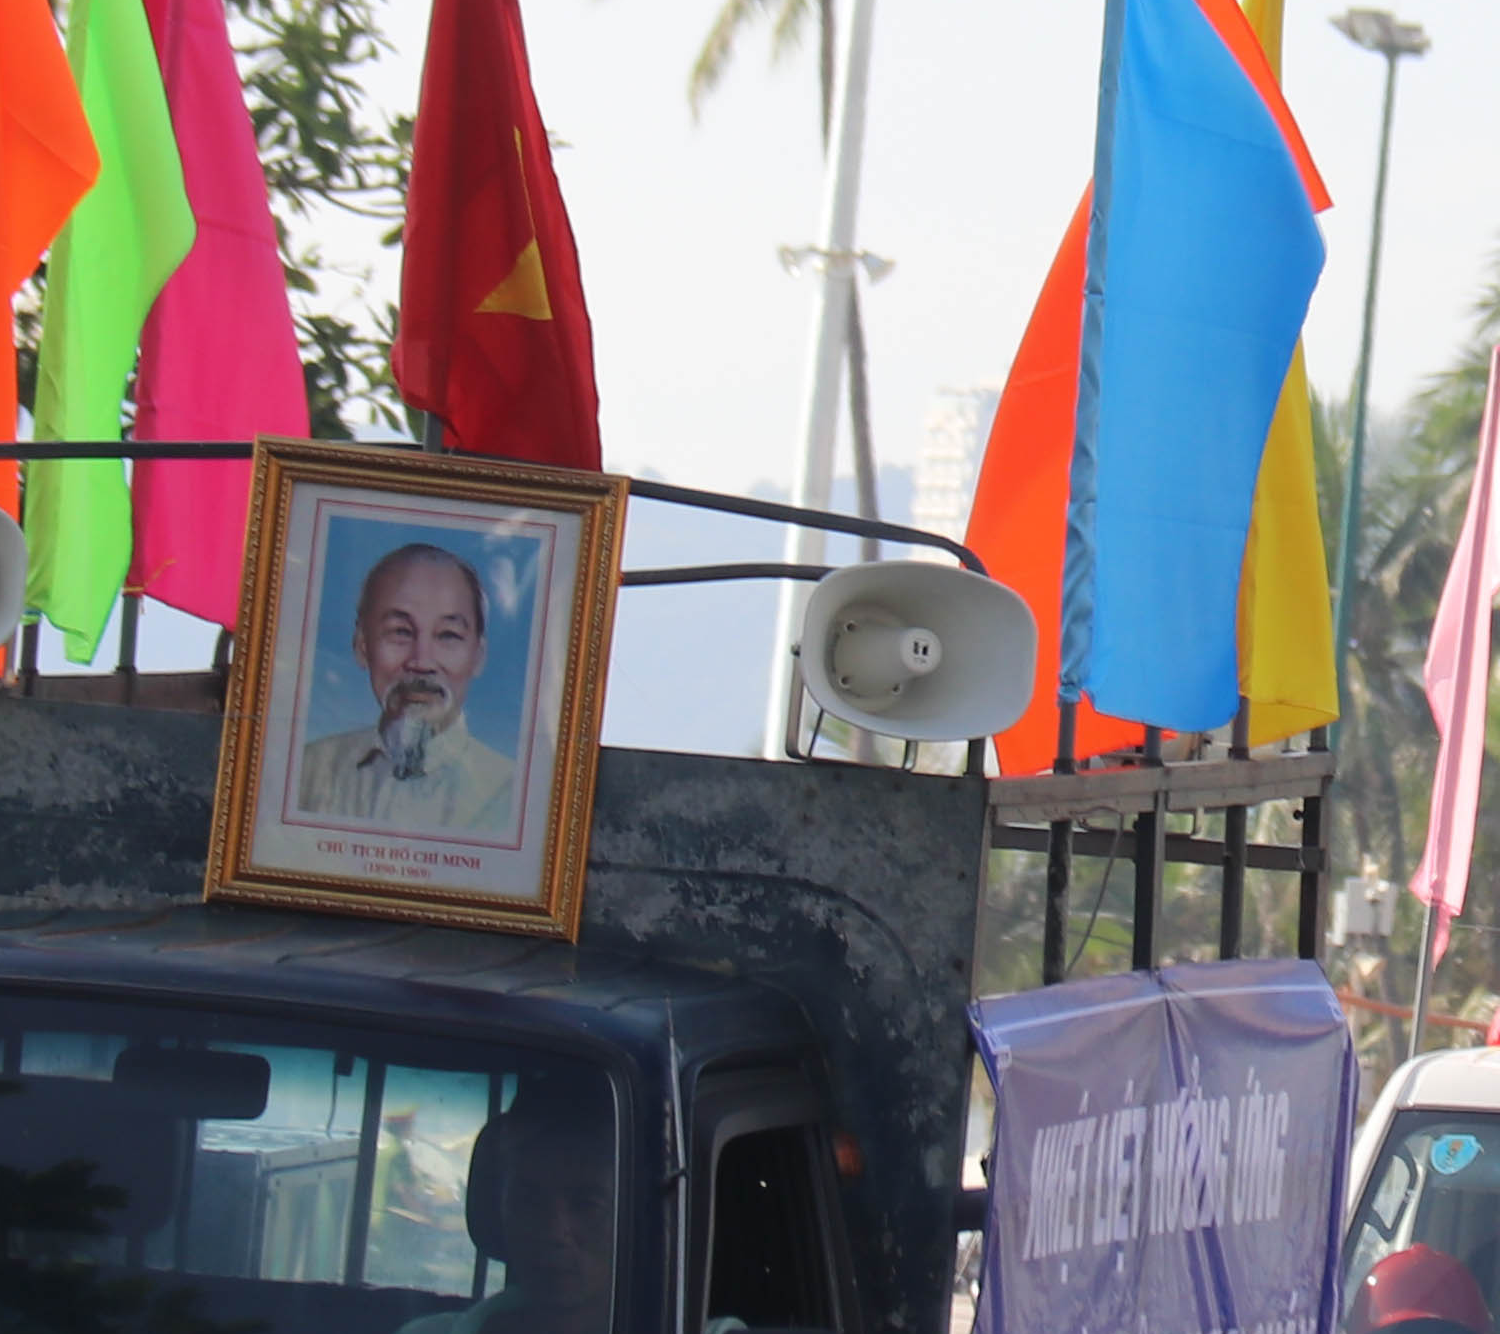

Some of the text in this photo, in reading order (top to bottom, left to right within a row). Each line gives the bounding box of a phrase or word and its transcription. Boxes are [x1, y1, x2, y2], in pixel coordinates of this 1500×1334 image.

[351, 843, 386, 860] TỊCH
[442, 854, 482, 870] MINH
[1092, 1078, 1147, 1273] LIỆT
[1231, 1066, 1290, 1226] ỨNG
